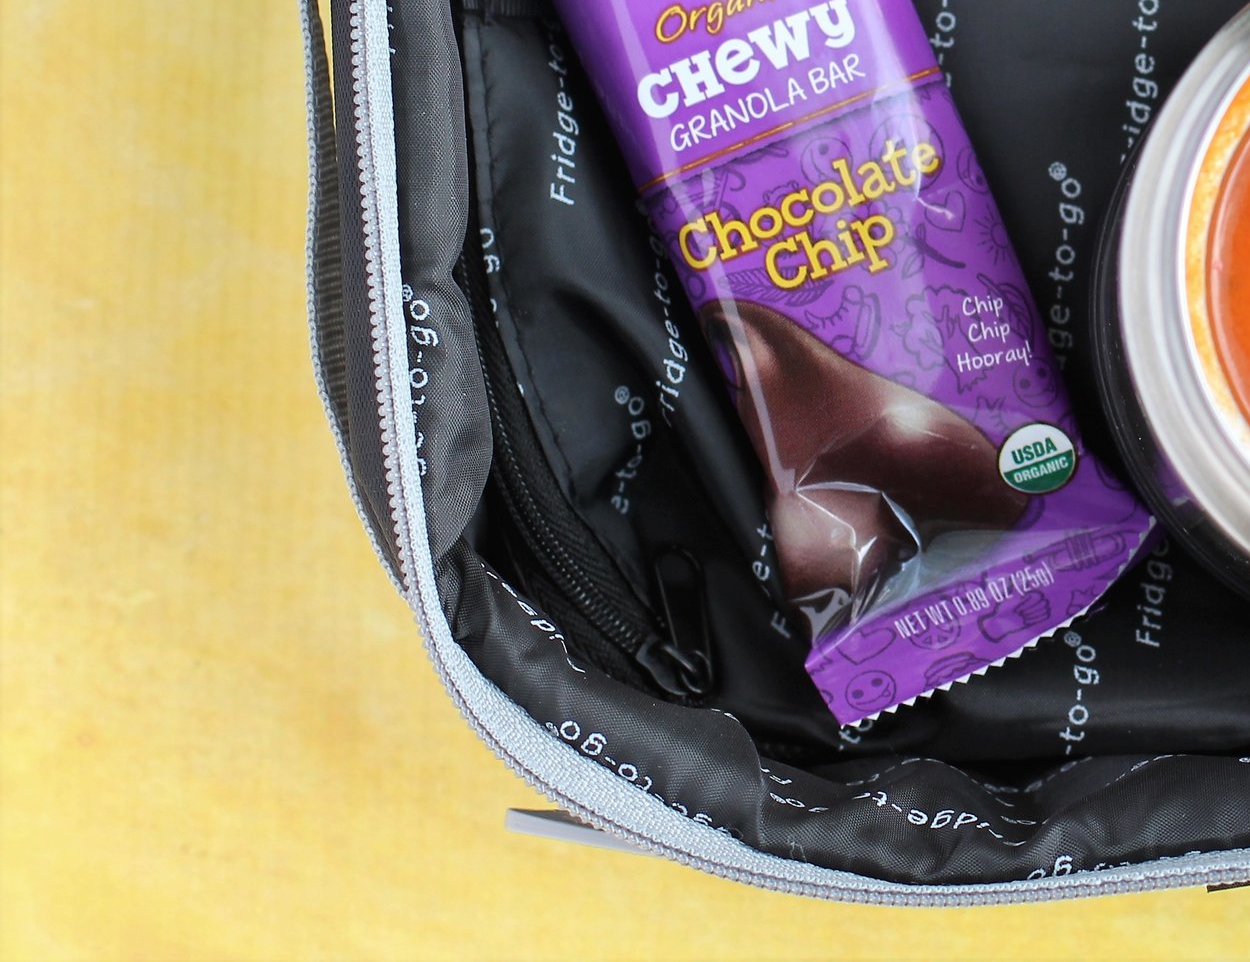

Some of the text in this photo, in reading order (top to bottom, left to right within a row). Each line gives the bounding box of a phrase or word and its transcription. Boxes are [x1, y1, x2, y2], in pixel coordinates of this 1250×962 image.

[669, 53, 866, 152] GRANOLA BAR
[678, 139, 942, 271] Chocolate
[764, 214, 895, 290] Chip
[962, 295, 1004, 317] Chip
[968, 321, 1011, 343] Chip
[956, 340, 1033, 373] Hooray!
[1011, 437, 1058, 465] USDA
[1013, 456, 1069, 484] ORGANIC
[894, 561, 1055, 639] NET WT 0.89 OZ (25g)
